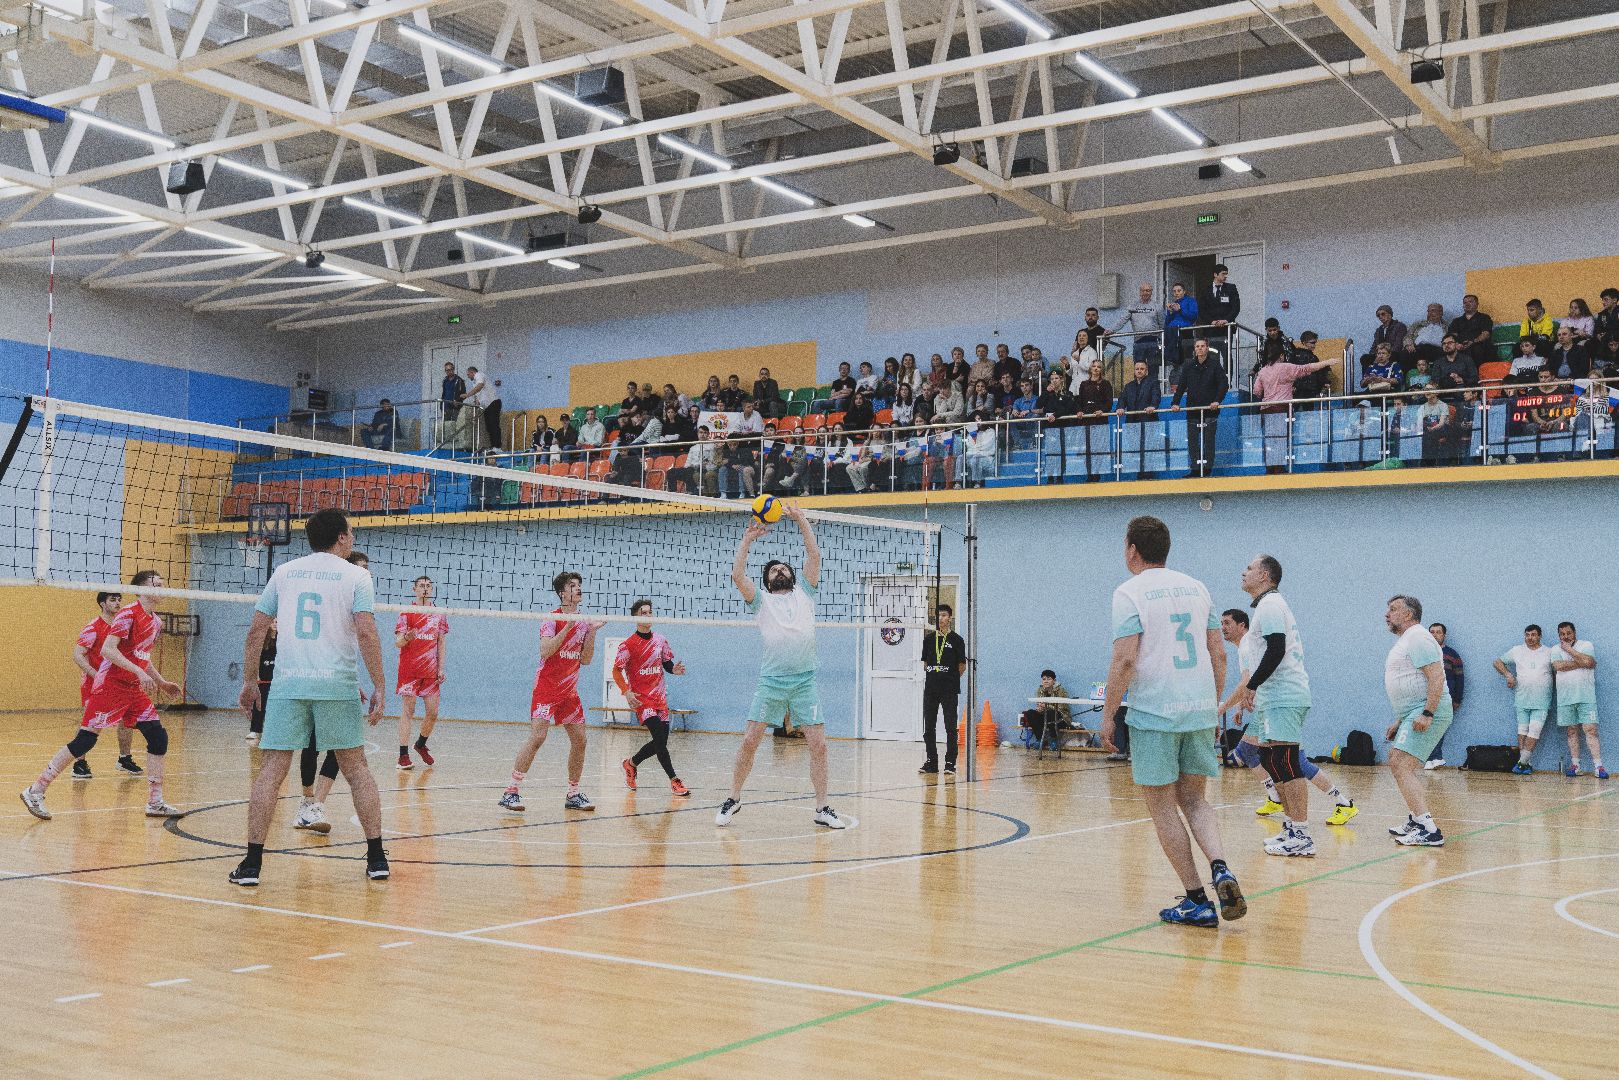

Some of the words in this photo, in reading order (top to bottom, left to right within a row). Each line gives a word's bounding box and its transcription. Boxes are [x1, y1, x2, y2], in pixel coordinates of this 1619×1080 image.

[286, 569, 314, 580] СОВЕТ
[295, 591, 323, 641] 6
[1169, 612, 1198, 670] 3
